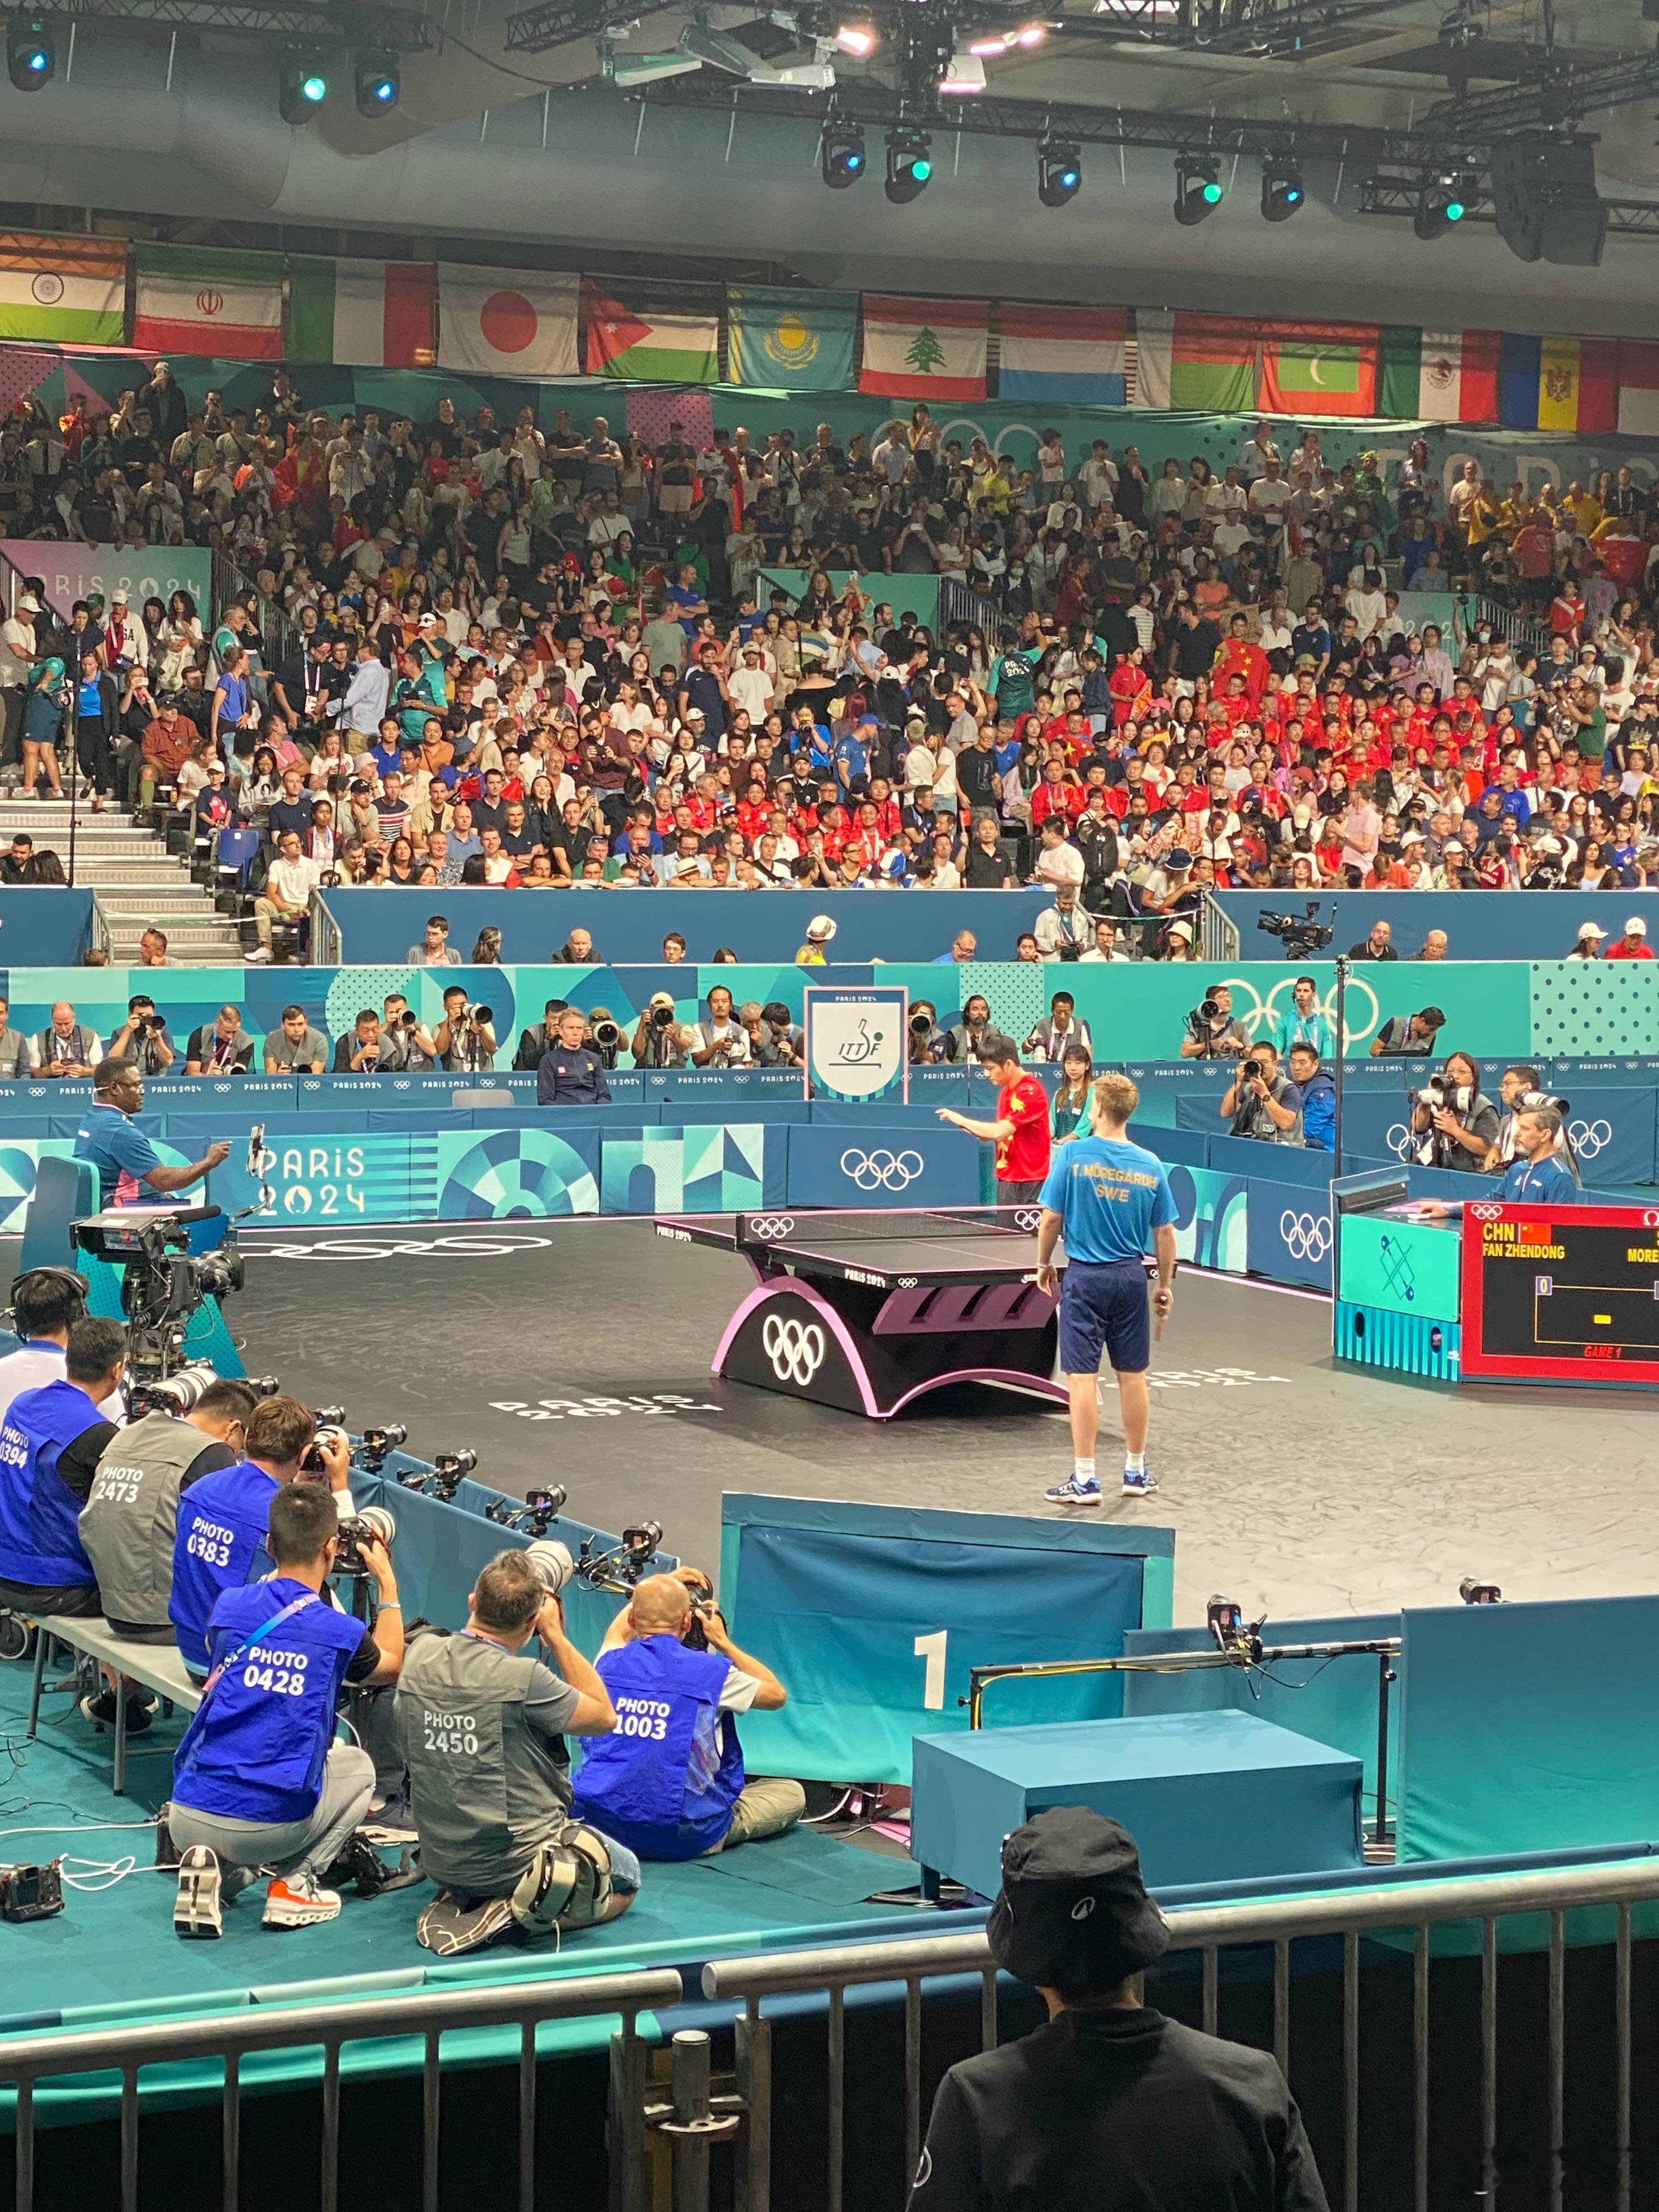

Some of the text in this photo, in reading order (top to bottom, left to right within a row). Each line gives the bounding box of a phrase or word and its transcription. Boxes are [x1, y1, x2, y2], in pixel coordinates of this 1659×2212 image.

[839, 1043, 881, 1056] ITTF
[259, 1184, 364, 1216] 2024
[1097, 1184, 1130, 1202] SWE
[1483, 1223, 1514, 1242] CHN
[1483, 1244, 1565, 1260] FAN ZHENDONG
[866, 1273, 886, 1288] 2024
[1541, 1278, 1548, 1293] 0
[1584, 1346, 1623, 1359] GAME 1
[516, 1403, 724, 1420] 2024
[2, 1426, 29, 1449] PHOTO
[0, 1440, 28, 1469] 0394
[101, 1466, 143, 1482] PHOTO
[95, 1482, 138, 1504] 2473
[192, 1516, 234, 1545] PHOTO
[187, 1539, 230, 1567] 0383
[249, 1646, 308, 1670] PHOTO
[914, 1629, 947, 1710] 1
[244, 1665, 305, 1696] 0428
[616, 1697, 670, 1718] PHOTO
[424, 1711, 476, 1731] PHOTO
[613, 1715, 667, 1740] 1003
[424, 1731, 478, 1755] 2450
